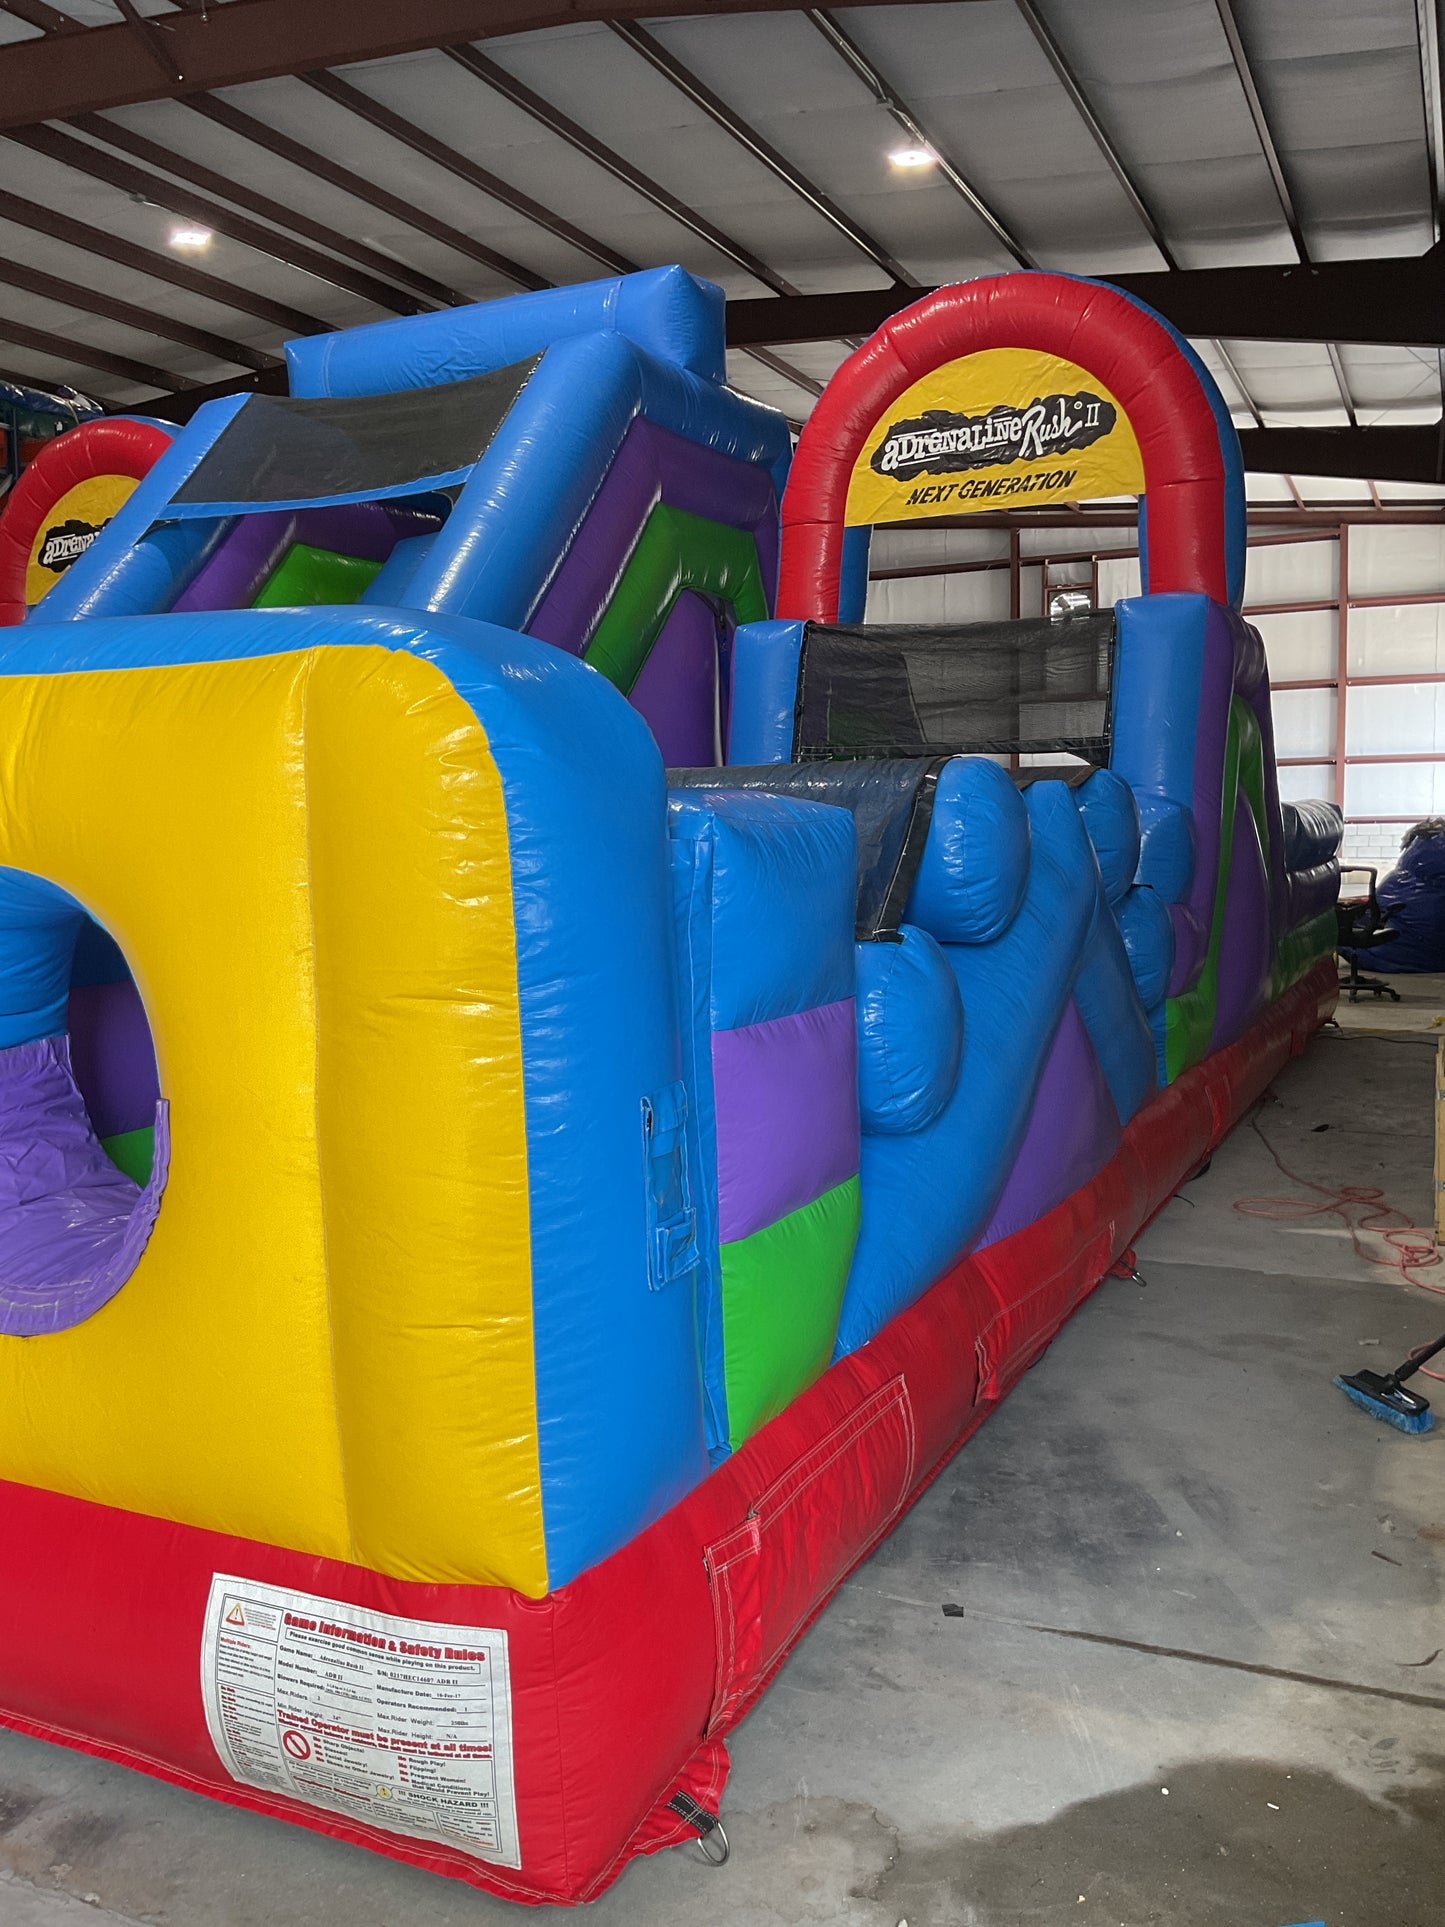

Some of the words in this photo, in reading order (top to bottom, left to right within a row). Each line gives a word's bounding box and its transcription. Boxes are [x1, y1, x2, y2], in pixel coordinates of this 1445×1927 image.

[1085, 402, 1101, 428] II
[905, 483, 959, 506] NEXT
[958, 470, 1077, 500] GENERATION
[221, 1637, 236, 1645] Multiple
[284, 1613, 317, 1631] Game
[318, 1621, 386, 1649] Information
[388, 1641, 396, 1652] &
[400, 1641, 442, 1659] Safety
[444, 1647, 486, 1661] Rules
[280, 1645, 295, 1654] Game
[296, 1650, 312, 1658] Name:
[290, 1632, 307, 1640] Please
[308, 1636, 331, 1646] exercise
[332, 1642, 345, 1650] good
[346, 1646, 367, 1656] common
[369, 1652, 384, 1660] sense
[402, 1658, 423, 1667] playing
[448, 1664, 476, 1672] product.
[278, 1660, 293, 1668] Model
[295, 1664, 317, 1674] Number:
[277, 1674, 298, 1684] Blowers
[300, 1680, 325, 1690] Required:
[376, 1684, 414, 1696] Manufacture
[377, 1698, 406, 1708] Operators
[408, 1703, 456, 1712] Recommended:
[277, 1709, 309, 1724] Trained
[311, 1718, 349, 1734] Operator
[351, 1730, 374, 1740] must
[377, 1734, 388, 1743] be
[391, 1737, 428, 1749] present
[430, 1742, 440, 1750] at
[459, 1744, 492, 1752] times!
[323, 1739, 339, 1747] Sharp
[409, 1758, 428, 1766] Rough
[410, 1765, 436, 1774] Flipping!
[410, 1772, 438, 1780] Pregnant
[412, 1779, 435, 1787] Medical
[409, 1793, 438, 1802] SHOCK
[441, 1800, 478, 1808] HAZARD
